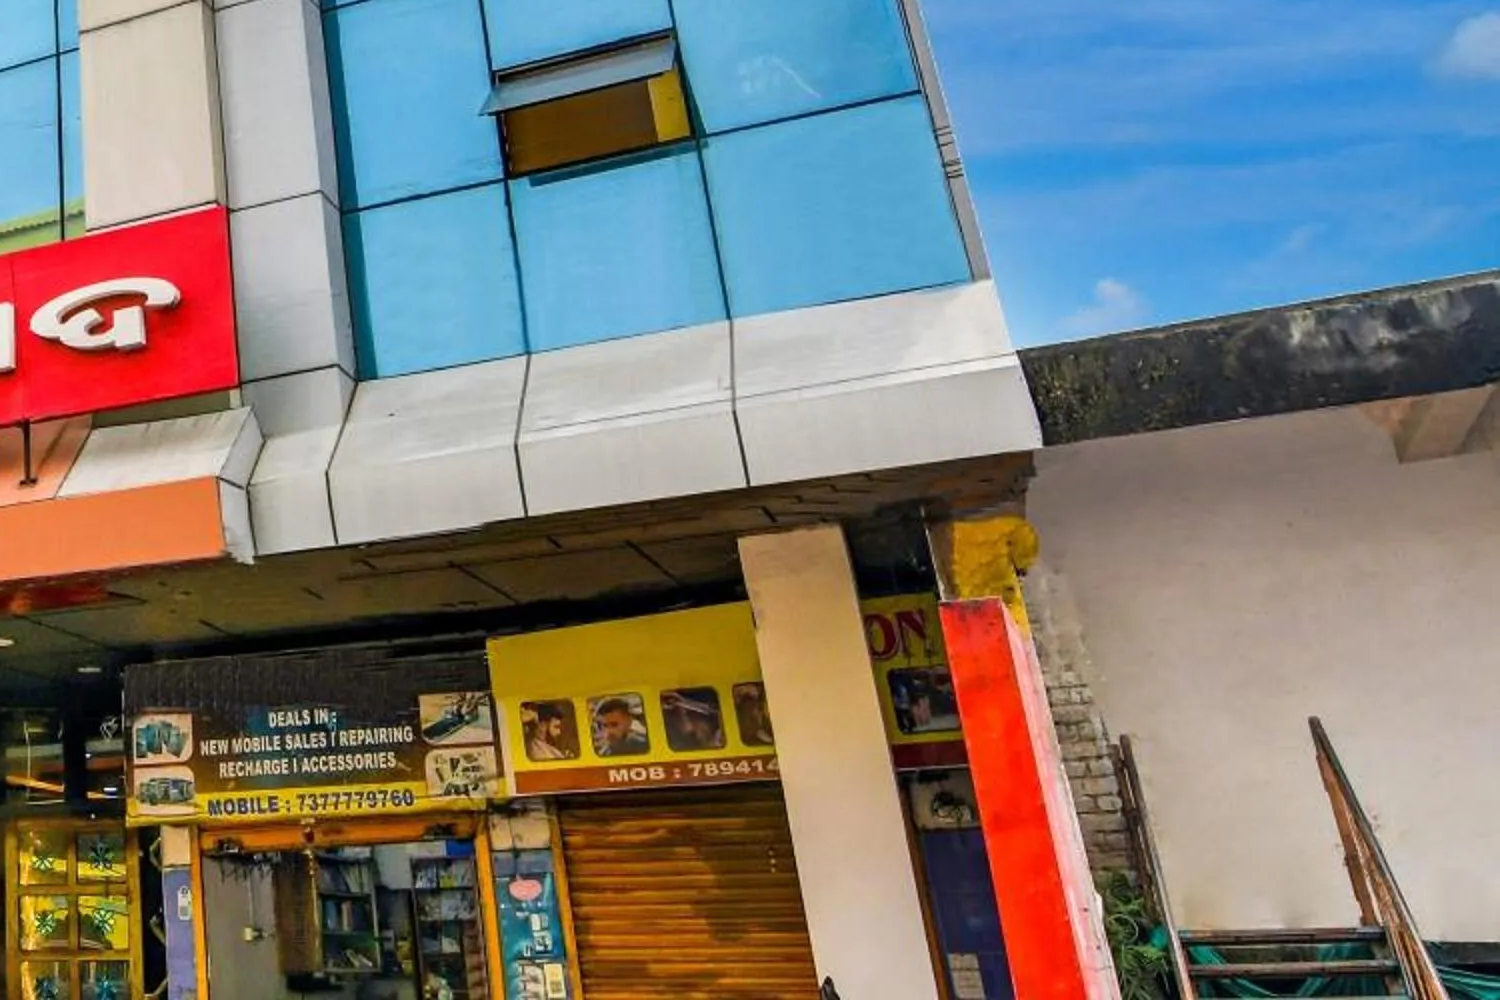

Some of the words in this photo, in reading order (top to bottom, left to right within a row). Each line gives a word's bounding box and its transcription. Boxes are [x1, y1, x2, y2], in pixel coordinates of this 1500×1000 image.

[268, 709, 310, 728] DEALS
[314, 708, 328, 724] IN
[200, 739, 229, 756] NEW
[231, 735, 281, 753] MOBILE
[285, 731, 327, 750] SALES
[339, 726, 413, 746] REPAIRING
[219, 759, 289, 779] RECHARGE
[301, 751, 397, 773] ACCESSORIES
[608, 766, 666, 783] MOB
[207, 795, 279, 816] MOBILE
